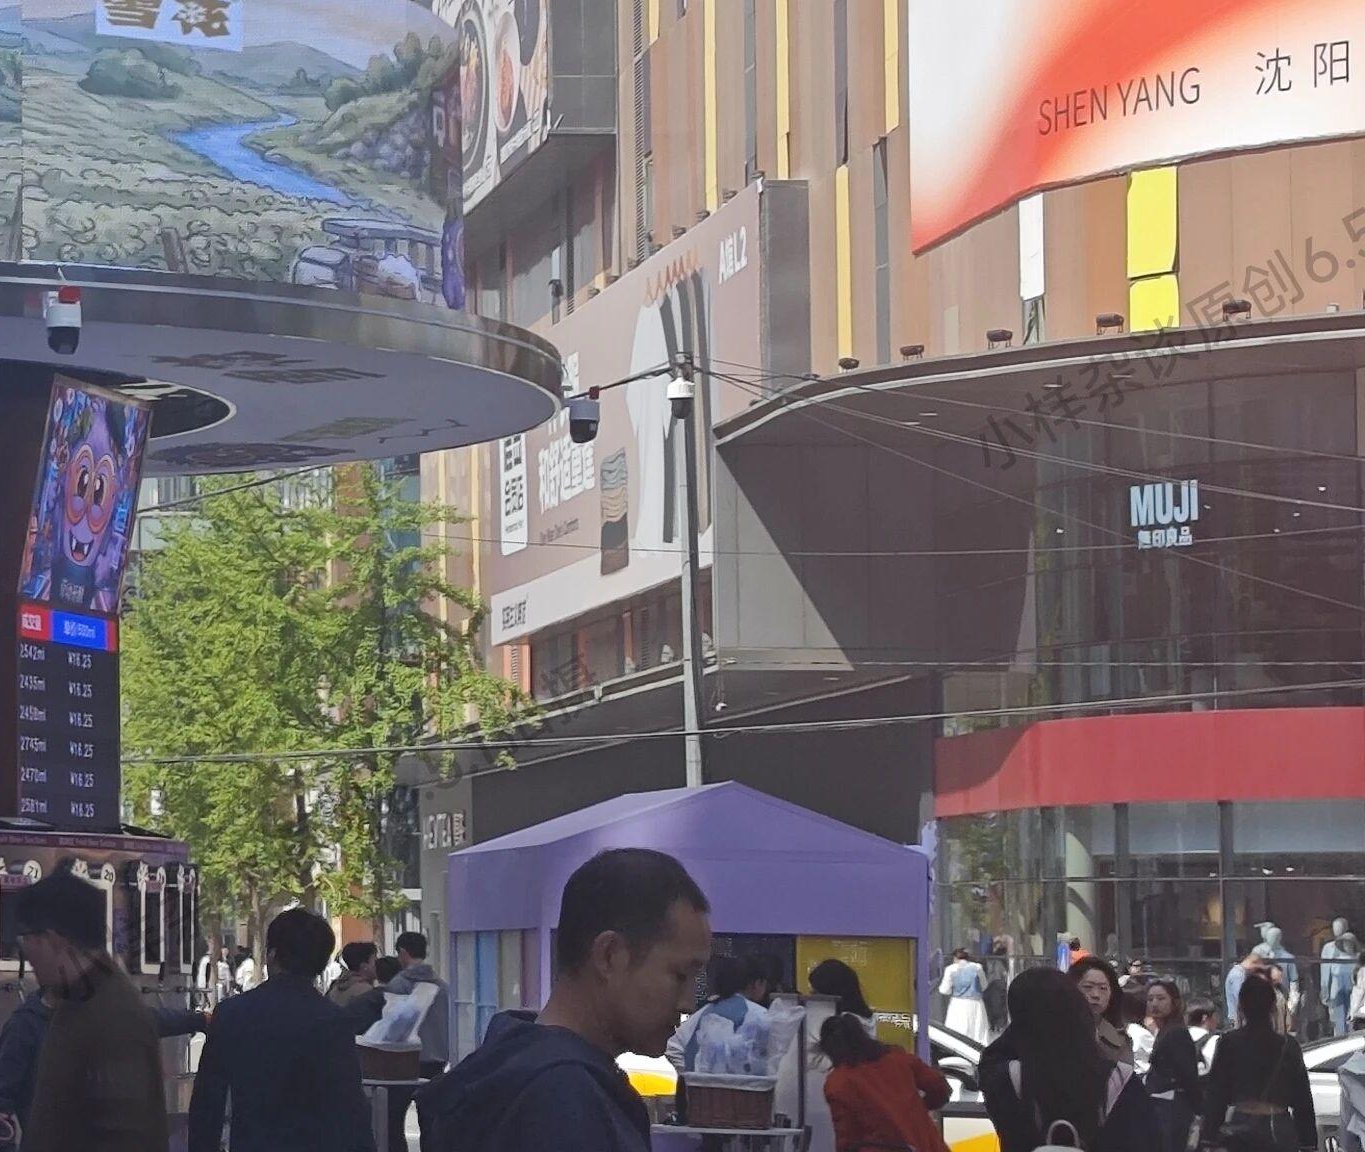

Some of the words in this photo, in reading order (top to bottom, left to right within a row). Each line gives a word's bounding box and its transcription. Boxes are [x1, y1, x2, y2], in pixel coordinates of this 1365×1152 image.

[1255, 40, 1351, 96] 沈阳
[1037, 84, 1108, 137] SHEN
[1117, 66, 1201, 117] YANG
[1130, 479, 1199, 527] MUJI
